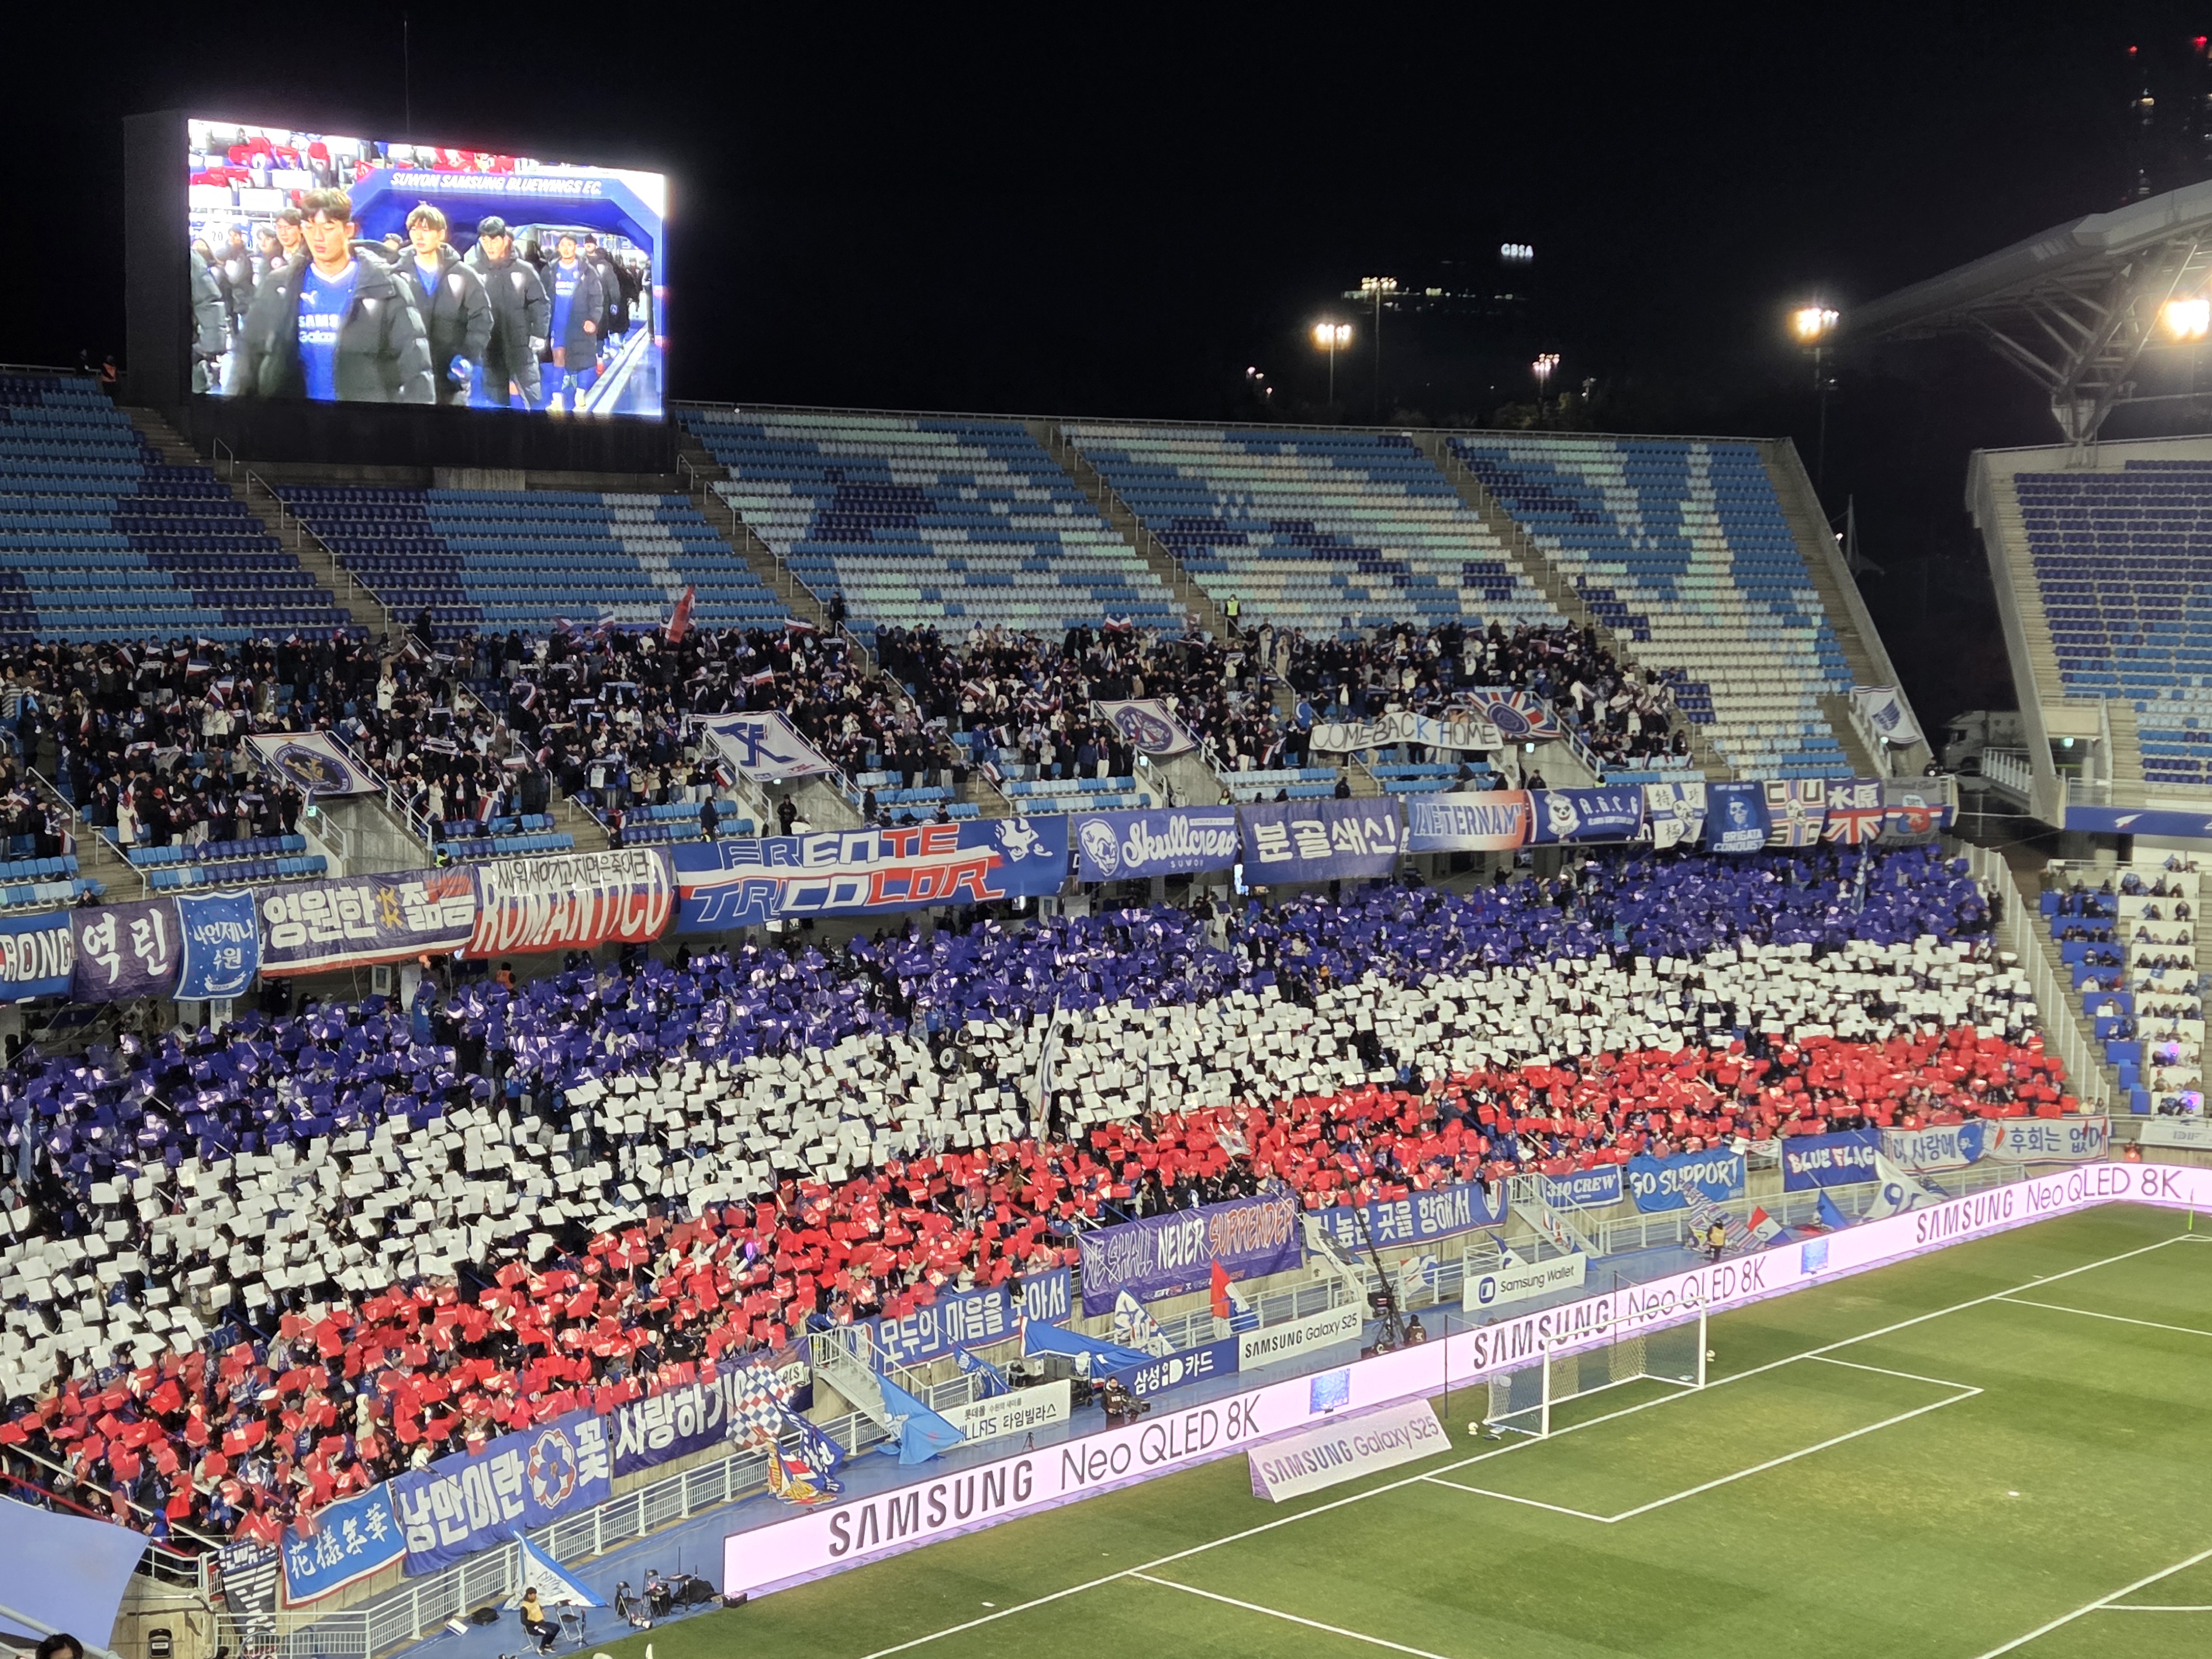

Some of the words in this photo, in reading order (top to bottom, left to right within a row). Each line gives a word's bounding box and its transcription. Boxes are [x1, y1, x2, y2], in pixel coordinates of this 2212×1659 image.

[390, 173, 440, 187] SUWON
[440, 175, 505, 190] SAMSUNG
[506, 178, 583, 193] BLUEWINGS
[1501, 243, 1533, 258] GBSA
[298, 314, 338, 327] SAMS
[1437, 722, 1496, 745] HOME
[1828, 784, 1879, 810] 水原
[718, 823, 961, 870] FRENTE
[1254, 815, 1397, 863] 분골쇄신
[1713, 839, 1766, 852] CONQUIST
[1722, 828, 1763, 842] BRIGATA
[471, 852, 669, 952] ROMANTICO
[690, 858, 1005, 922] TRICOLOR
[263, 886, 377, 948] 영원한
[399, 877, 475, 931] 젊음
[0, 928, 72, 982] RONG
[213, 948, 242, 971] 수원
[1787, 1148, 1832, 1173] BLUE
[1832, 1146, 1875, 1168] FLAG
[1912, 1134, 1956, 1162] 사랑에
[2010, 1126, 2062, 1154] 후회는
[1547, 1181, 1572, 1197] 310
[1573, 1174, 1616, 1193] CREW
[1629, 1172, 1656, 1199] GO
[1658, 1156, 1739, 1196] SUPPORT
[1378, 1201, 1413, 1241] 곳을
[1418, 1188, 1470, 1234] 향해서
[1916, 1190, 2013, 1244] SAMSUNG
[2026, 1182, 2063, 1213] Neo
[2067, 1167, 2131, 1203] QLED
[2141, 1168, 2184, 1199] 8K
[1107, 1228, 1153, 1284] SHALL
[1157, 1218, 1204, 1271] NEVER
[1209, 1198, 1295, 1259] SURRENDER
[1500, 1272, 1545, 1293] Samsung
[1547, 1264, 1574, 1282] Wallet
[880, 1308, 939, 1363] 모두의
[946, 1292, 1004, 1344] 마음을
[1473, 1300, 1609, 1369] SAMSUNG
[1628, 1289, 1674, 1326] Neo
[1682, 1265, 1735, 1310] QLED
[1741, 1255, 1768, 1292] 8K
[1245, 1331, 1303, 1359] SAMSUNG
[1306, 1317, 1340, 1340] Galaxy
[1341, 1313, 1358, 1331] S25
[779, 1365, 800, 1383] els
[1134, 1365, 1160, 1395] 삼성
[1185, 1351, 1214, 1377] 카드
[965, 1405, 985, 1421] 롯데몰
[1003, 1404, 1057, 1430] 타임빌라스
[1262, 1439, 1353, 1485] SAMSUNG
[1353, 1422, 1413, 1456] Galaxy
[1412, 1413, 1439, 1441] S25
[400, 1448, 525, 1553] 낭만이란
[575, 1417, 609, 1487] 꽃
[829, 1459, 1034, 1557] SAMSUNG
[1061, 1441, 1131, 1490] Neo
[1140, 1409, 1219, 1465] QLED
[1226, 1394, 1260, 1441] 8K
[290, 1503, 388, 1580] 花樣年華
